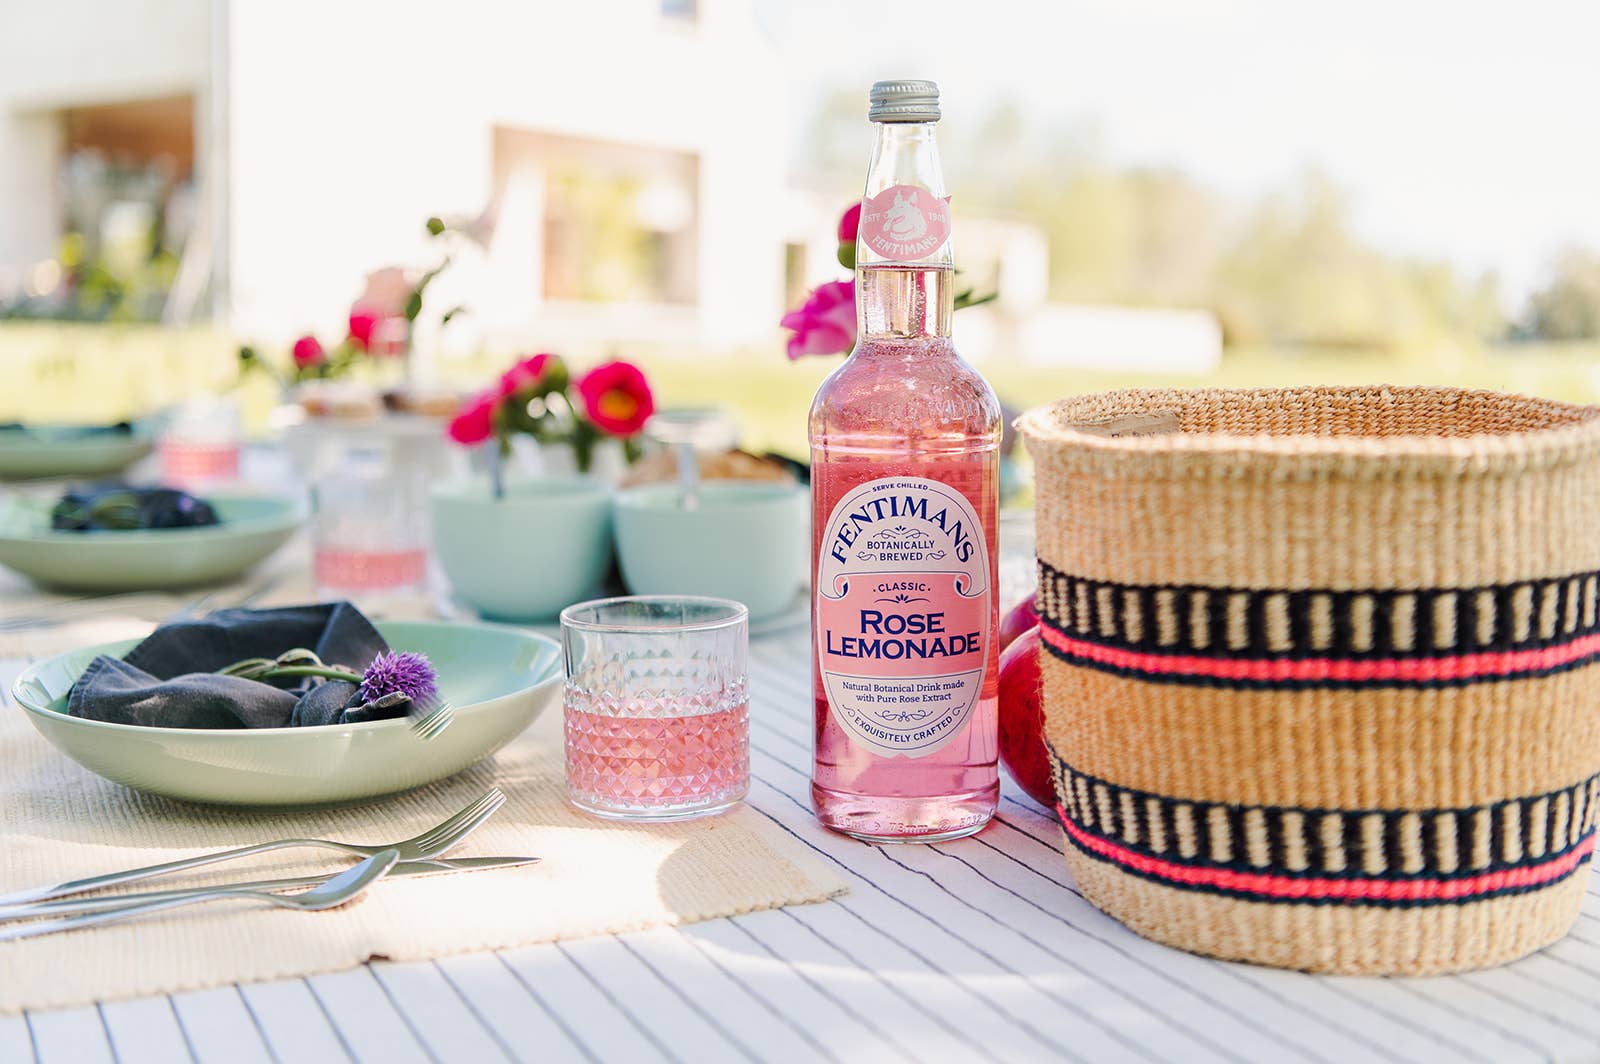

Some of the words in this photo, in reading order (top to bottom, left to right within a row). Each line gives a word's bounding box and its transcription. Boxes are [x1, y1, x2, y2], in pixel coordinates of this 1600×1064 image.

[872, 234, 938, 255] FENTIMANS
[872, 483, 895, 492] SERVE
[896, 483, 929, 491] CHILLED
[831, 496, 974, 565] FENTIMANS
[867, 540, 935, 550] BOTANICALLY
[879, 552, 923, 561] BREWED
[878, 582, 926, 592] CLASSIC
[860, 610, 945, 635] ROSE
[826, 630, 981, 660] LEMONADE
[842, 681, 872, 692] Natural
[873, 684, 915, 693] Botanical
[916, 682, 941, 692] Drink
[942, 680, 965, 690] made
[856, 693, 875, 703] with
[876, 695, 897, 703] Pure
[900, 695, 920, 703] Rose
[922, 693, 952, 702] Extract
[854, 716, 911, 743] EXQUISITELY
[913, 716, 953, 741] CRAFTED
